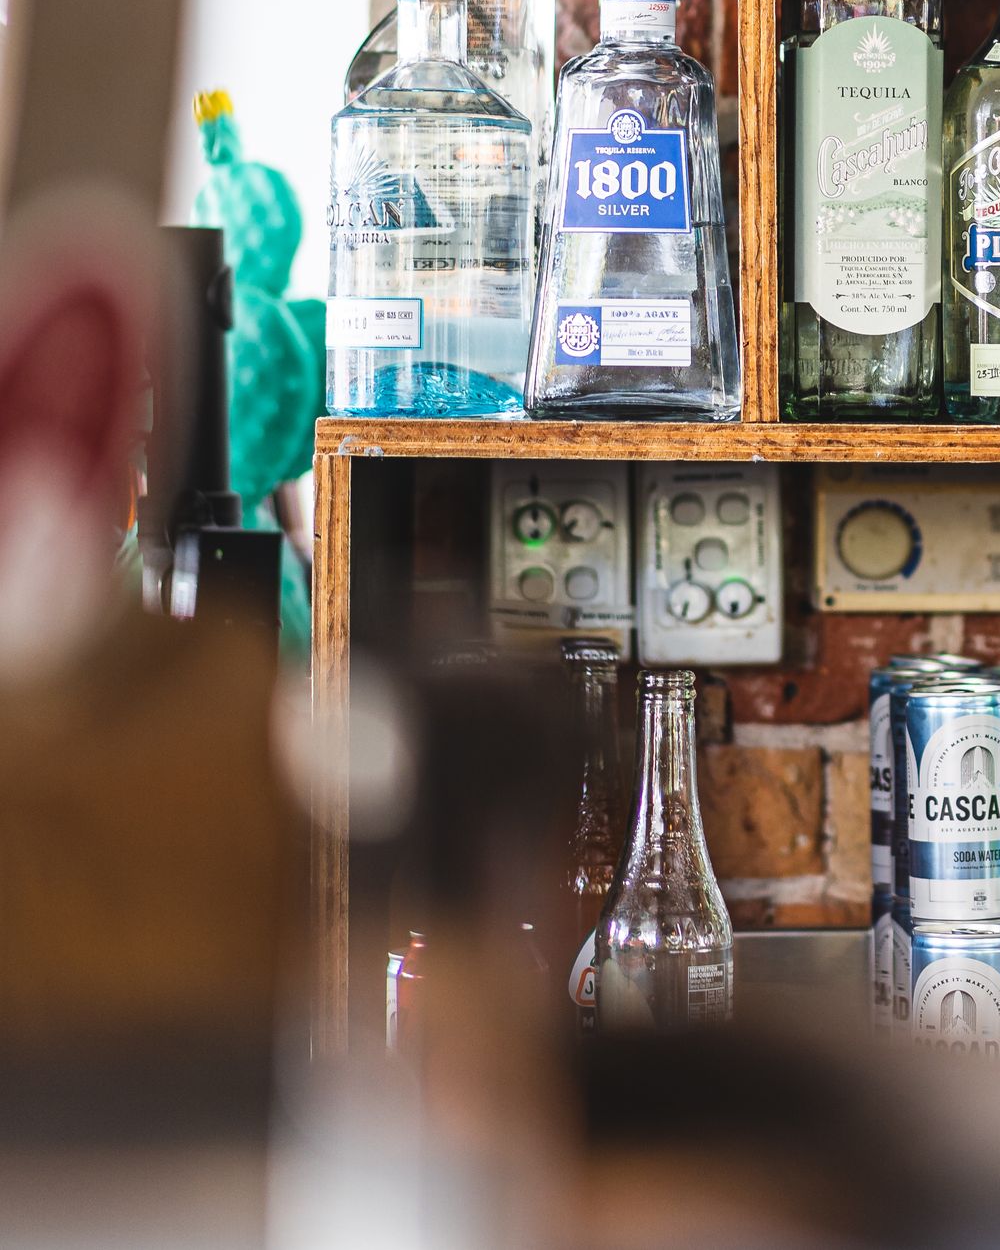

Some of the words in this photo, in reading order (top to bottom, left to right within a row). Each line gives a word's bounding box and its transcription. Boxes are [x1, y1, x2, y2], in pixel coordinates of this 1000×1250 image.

[837, 86, 911, 99] TEQUILA
[595, 146, 626, 155] TEQUILA
[626, 146, 656, 154] RESERVA
[574, 159, 677, 200] 1800
[893, 178, 928, 186] BLANCO
[597, 203, 650, 217] SILVER
[841, 255, 888, 263] PRODUCIDO
[610, 310, 640, 318] 100%
[644, 310, 679, 318] AGAVE
[840, 305, 861, 313] Cont.
[881, 305, 896, 313] 750
[938, 748, 949, 763] JUST
[950, 735, 969, 747] MAKE
[953, 850, 977, 863] SODA
[931, 978, 949, 991] MAKE
[965, 978, 985, 991] MAKE
